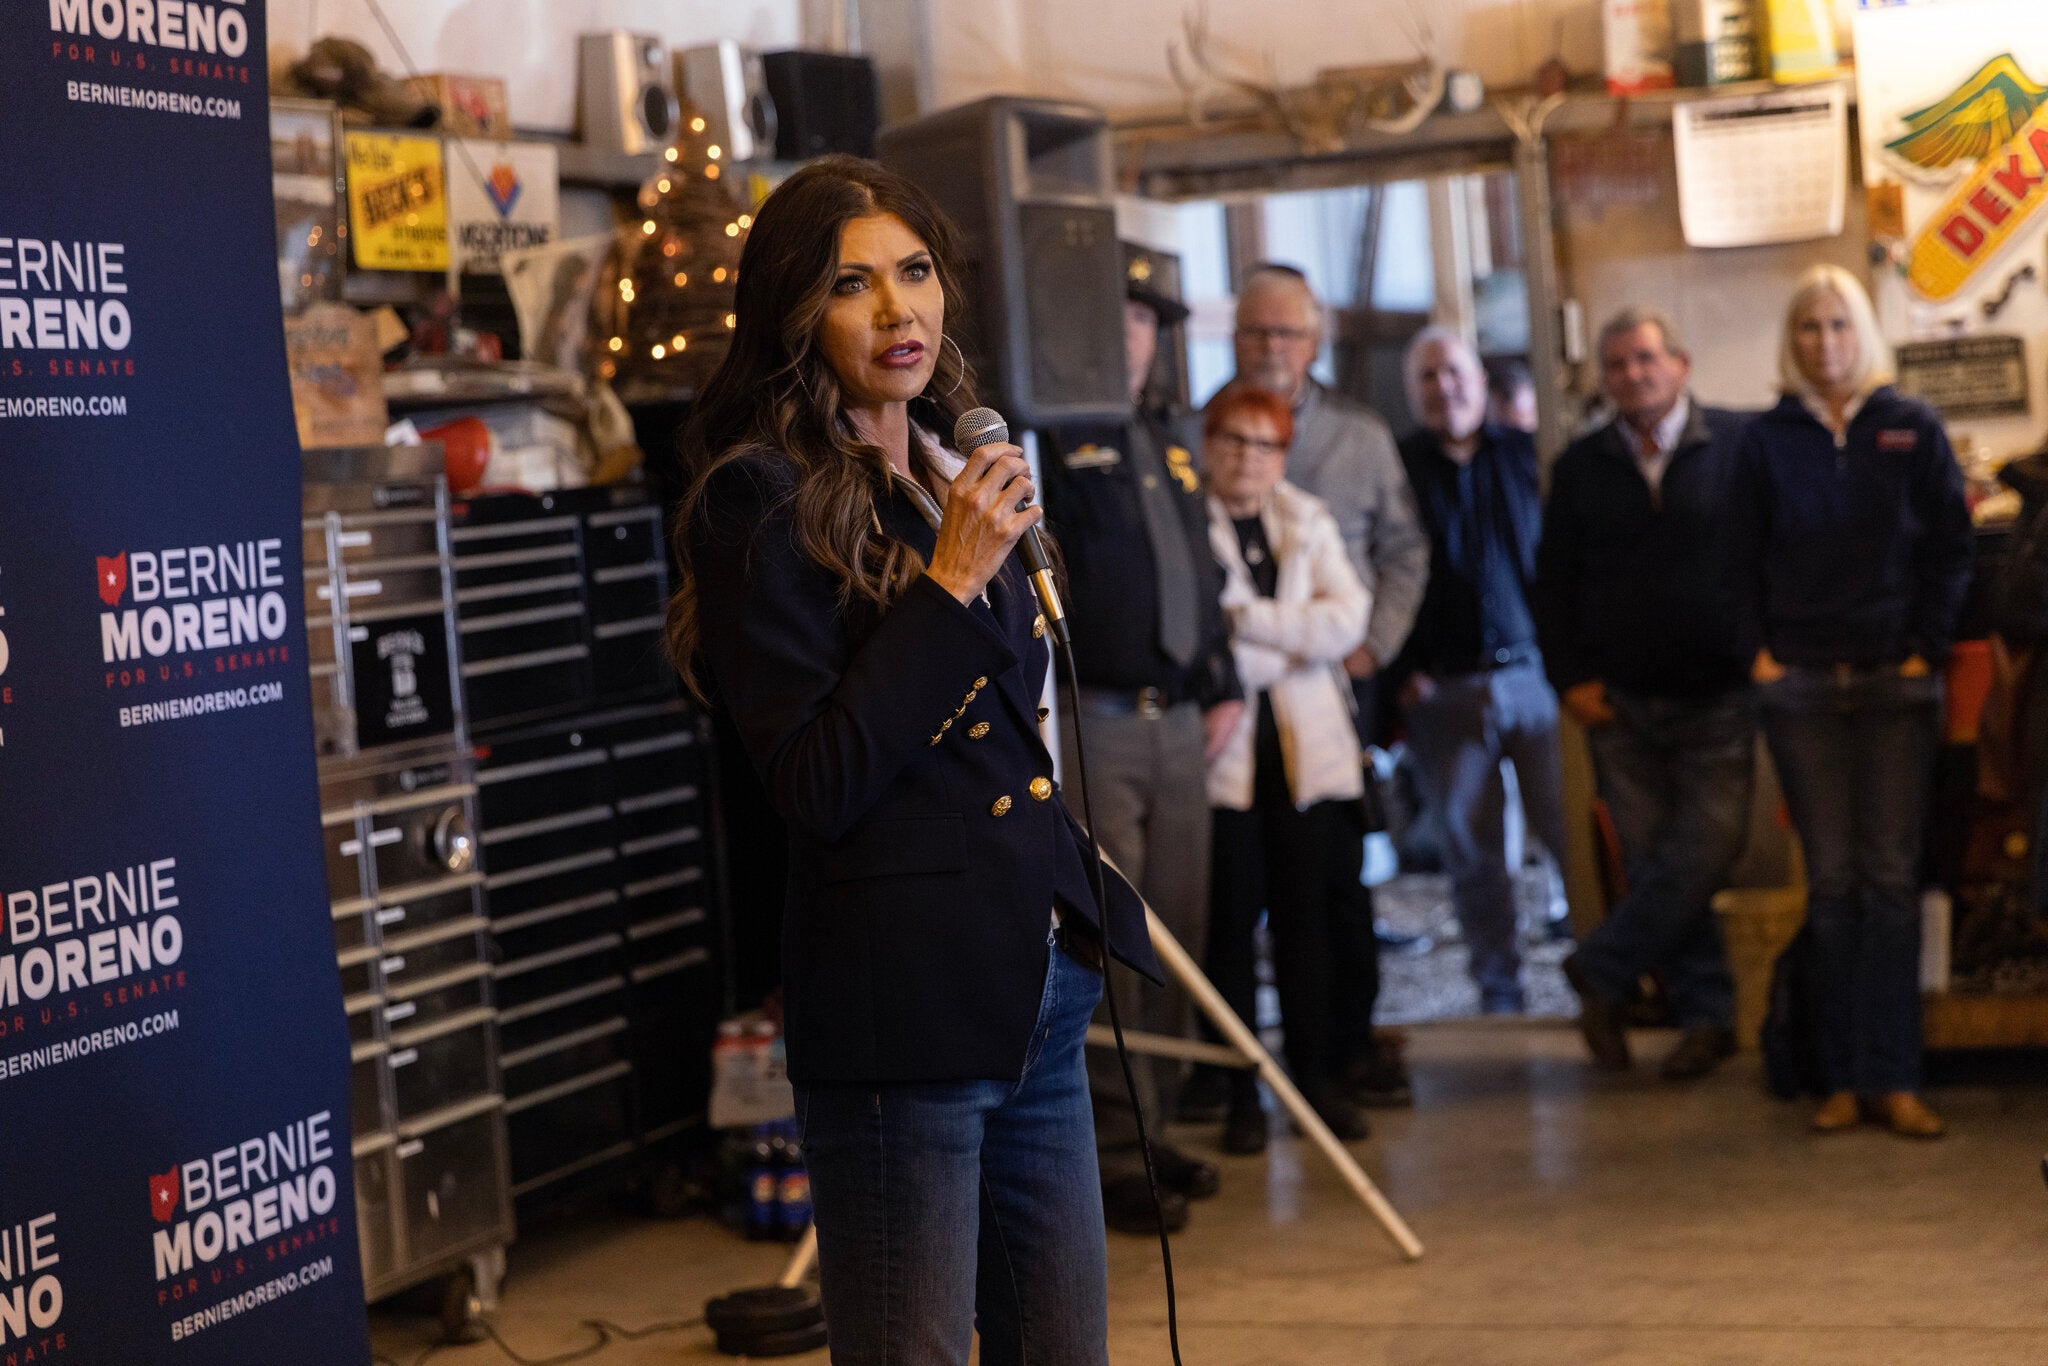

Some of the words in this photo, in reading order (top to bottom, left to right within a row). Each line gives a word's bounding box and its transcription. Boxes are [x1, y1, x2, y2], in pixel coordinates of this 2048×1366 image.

[49, 0, 249, 58] MORENO
[52, 41, 95, 63] FOR
[110, 51, 155, 70] U.S.
[169, 57, 249, 84] SENATE
[67, 79, 241, 120] BERNIEMORENO.COM
[0, 237, 128, 293] ERNIE
[0, 296, 132, 351] RENO
[49, 358, 136, 377] SENATE
[0, 395, 127, 418] EMORENO.COM
[129, 538, 284, 602] BERNIE
[100, 591, 288, 664] MORENO
[105, 667, 146, 689] FOR
[159, 660, 203, 682] U.S.
[215, 646, 290, 673] SENATE
[119, 681, 284, 728] BERNIEMORENO.COM
[7, 857, 180, 946] BERNIE
[0, 1015, 24, 1037] OR
[41, 1000, 88, 1025] U.S.
[102, 970, 186, 1008] SENATE
[0, 1008, 180, 1081] BERNIEMORENO.COM
[181, 1109, 334, 1213] BERNIE
[152, 1164, 337, 1282] MORENO
[157, 1277, 199, 1307] FOR
[210, 1258, 254, 1285] U.S.
[265, 1217, 339, 1262] SENATE
[170, 1255, 334, 1343] BERNIEMORENO.COM
[6, 1332, 66, 1366] NATE
